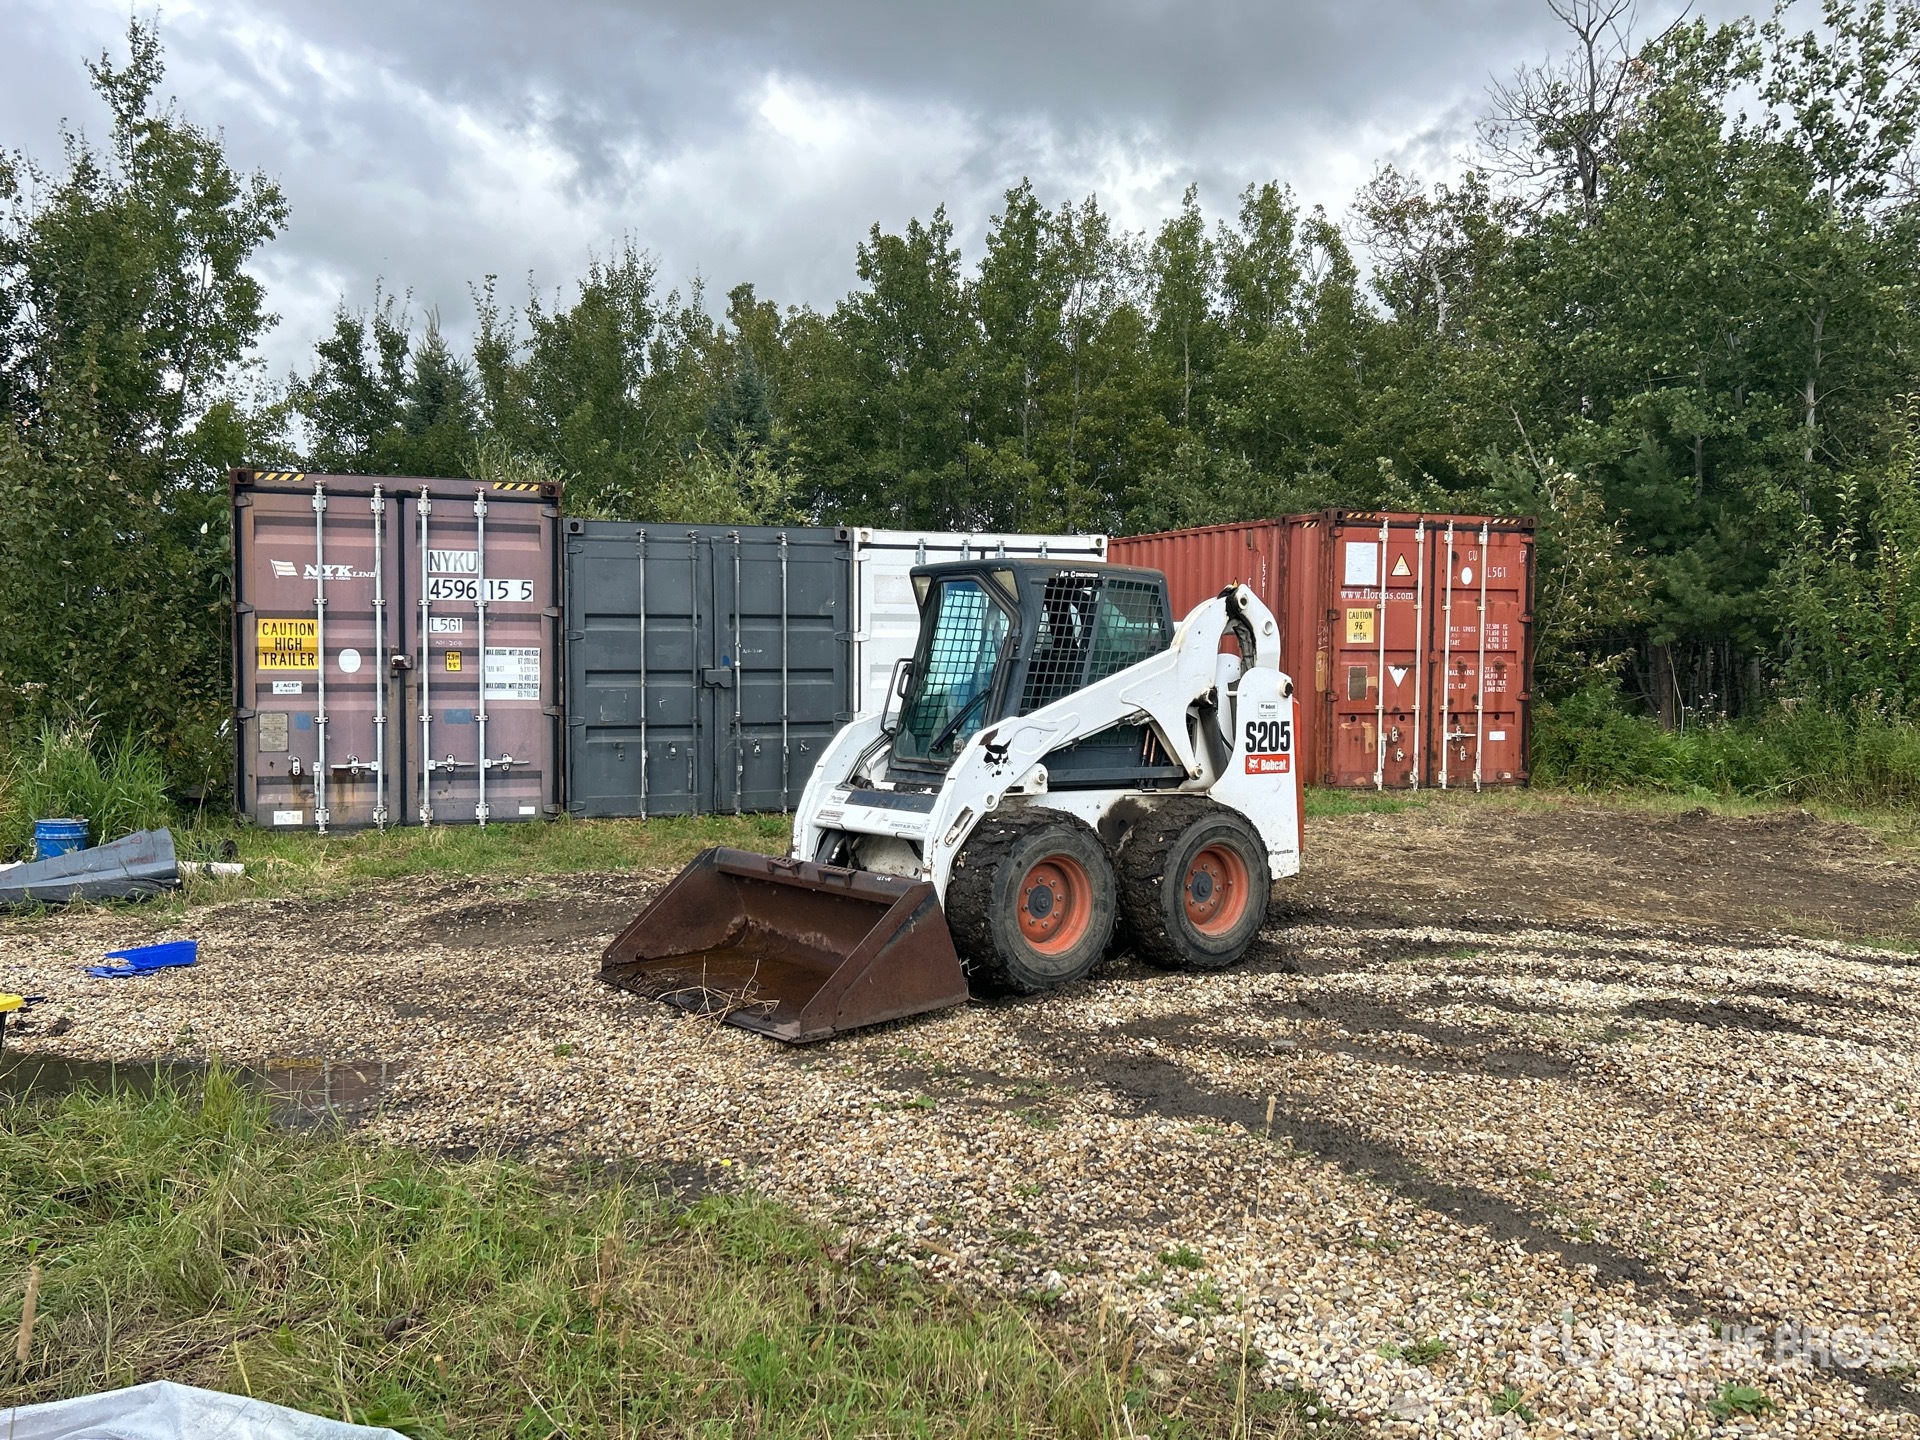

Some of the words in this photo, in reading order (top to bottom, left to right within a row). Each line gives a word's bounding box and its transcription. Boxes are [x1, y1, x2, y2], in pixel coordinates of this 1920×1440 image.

[429, 551, 477, 572] NYKU
[303, 564, 354, 577] NYK
[521, 581, 532, 601] 5
[1348, 611, 1373, 619] CAUTION
[262, 622, 315, 636] CAUTION
[1353, 632, 1367, 640] HIGH
[274, 637, 302, 651] HIGH
[262, 652, 315, 667] TRAILER
[1245, 720, 1291, 753] S205
[1260, 759, 1287, 771] Bobcat
